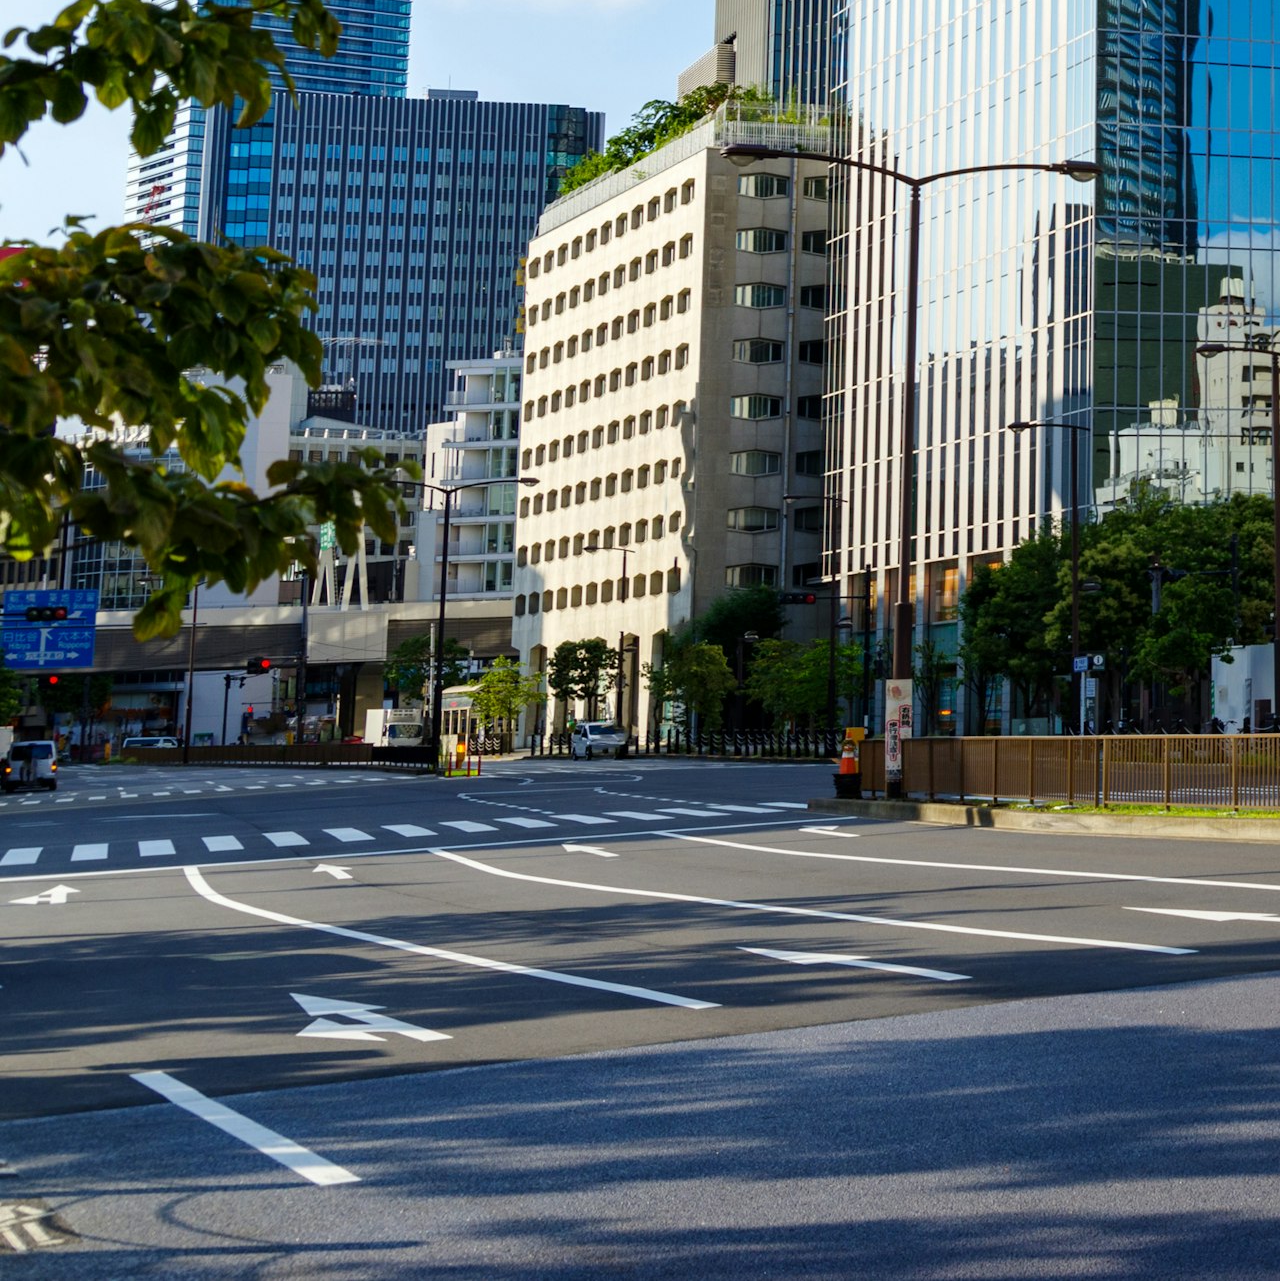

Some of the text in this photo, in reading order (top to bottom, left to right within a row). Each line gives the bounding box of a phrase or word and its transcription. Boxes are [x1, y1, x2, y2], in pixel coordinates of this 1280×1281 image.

[4, 632, 37, 642] 日比谷
[58, 631, 92, 641] 六本木
